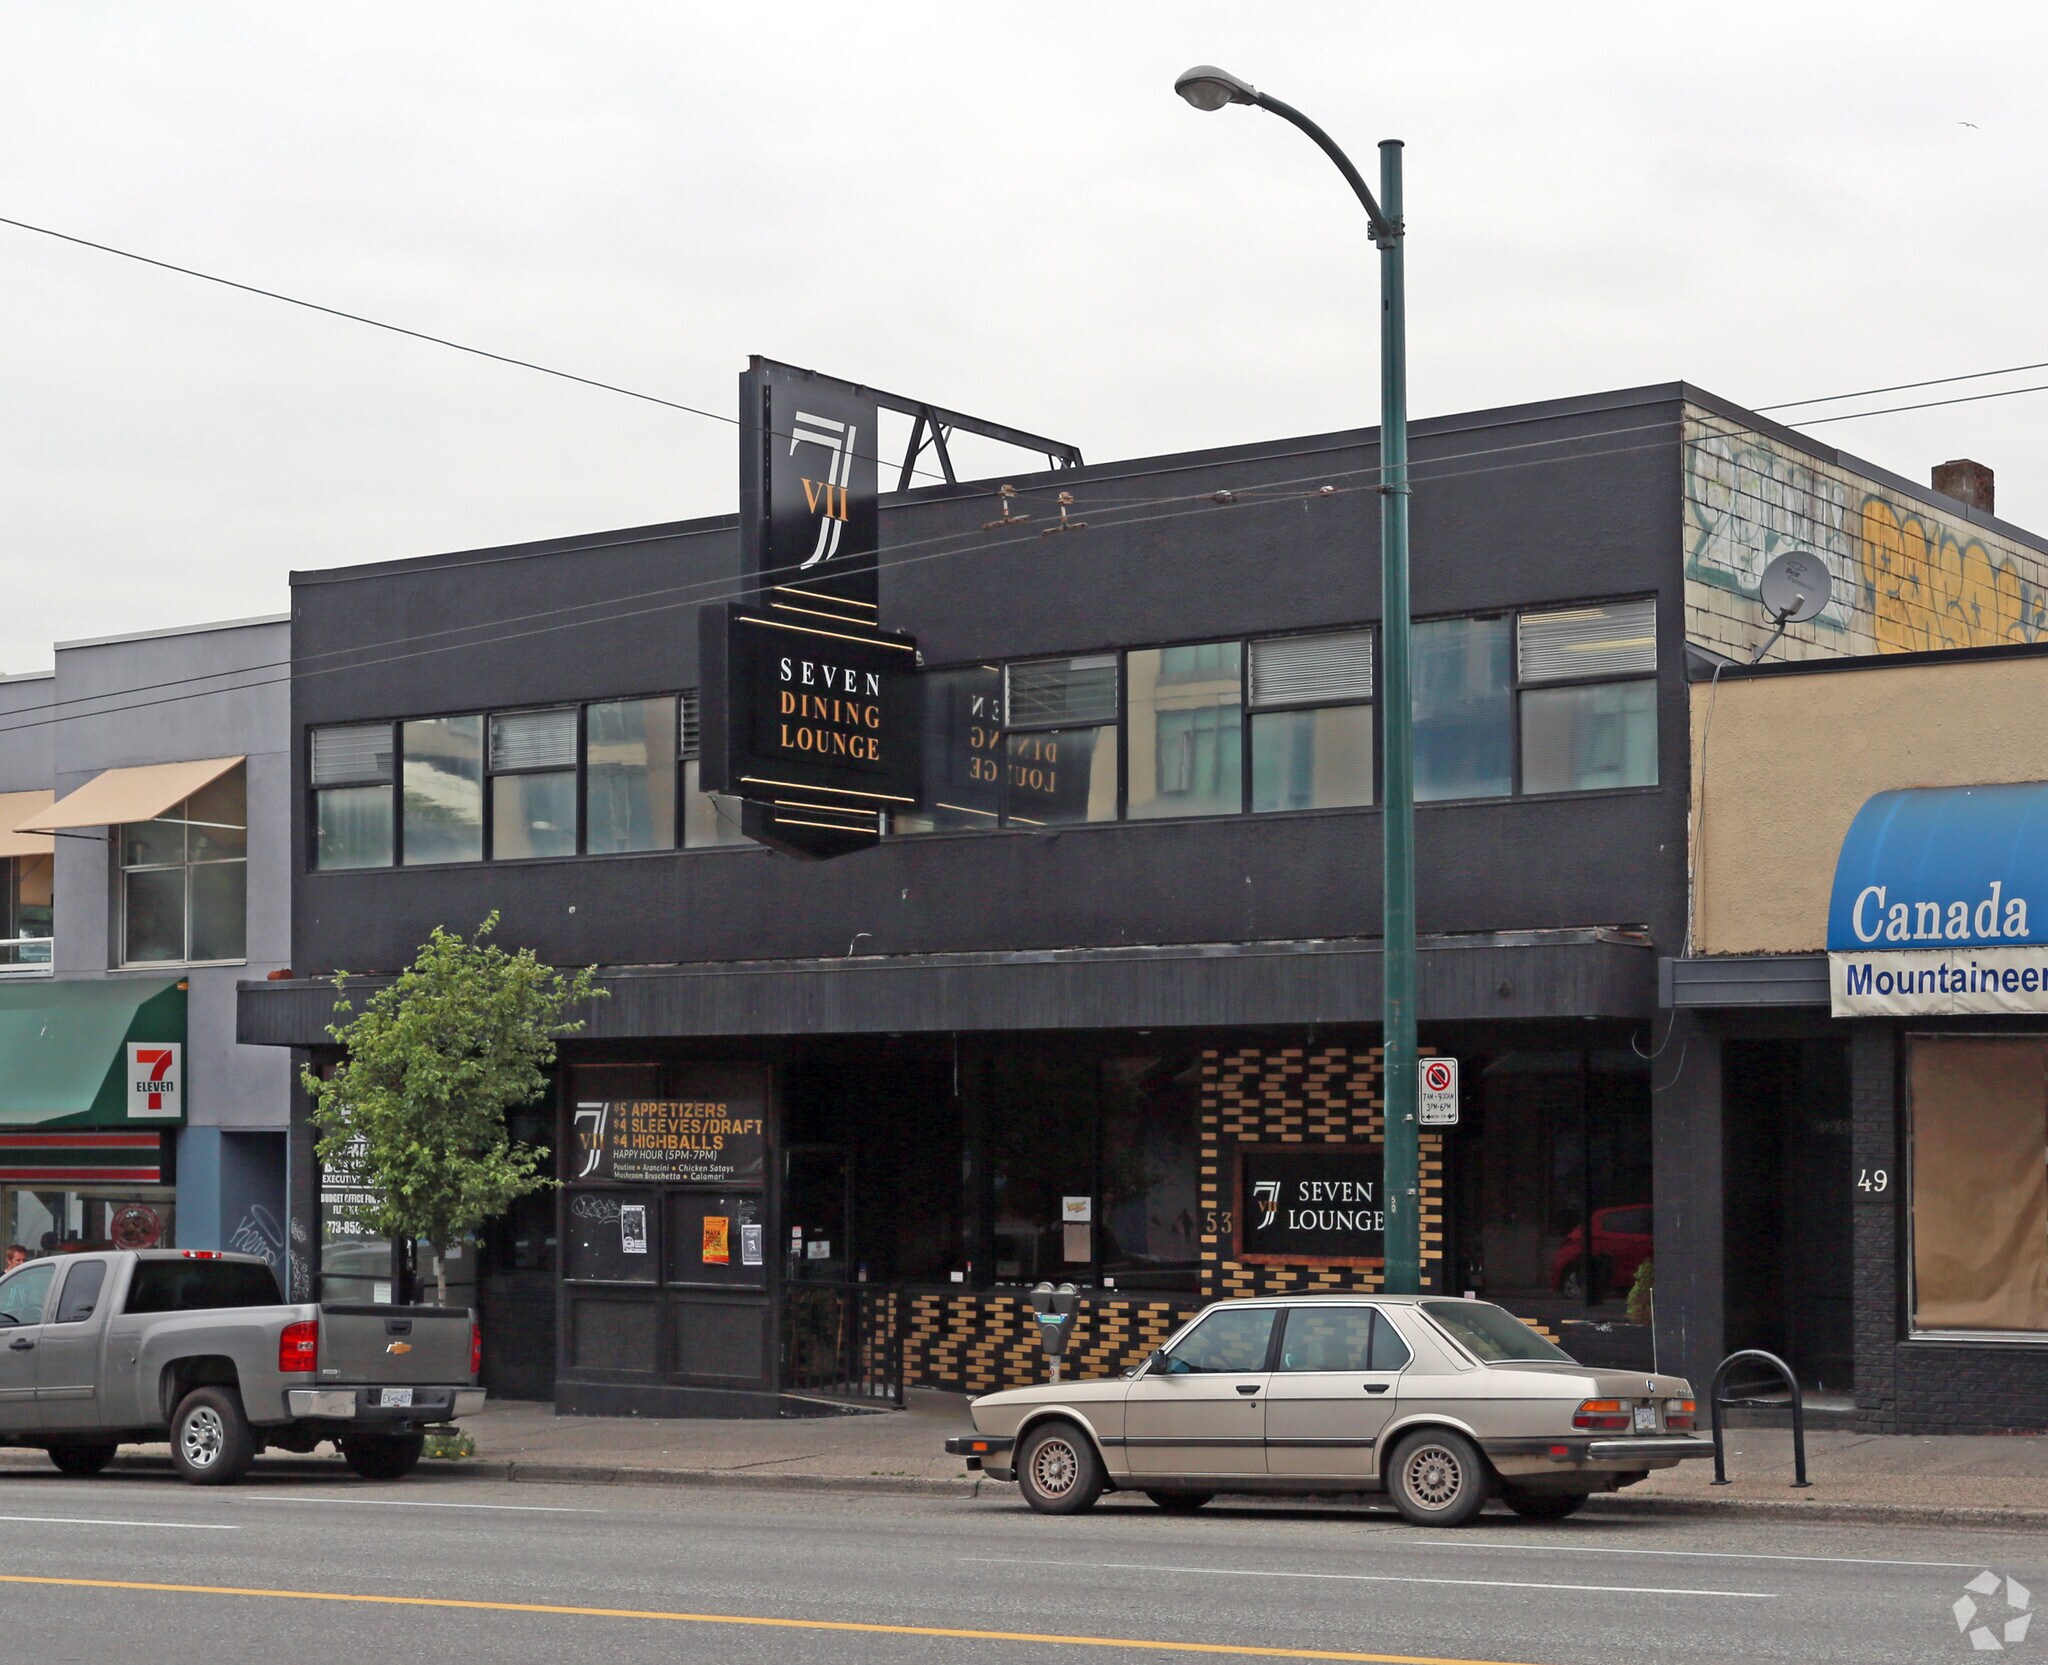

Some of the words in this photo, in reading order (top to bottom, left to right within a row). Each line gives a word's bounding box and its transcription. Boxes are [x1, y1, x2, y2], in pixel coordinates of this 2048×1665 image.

[801, 478, 849, 522] VII
[780, 657, 881, 698] SEVEN
[780, 690, 881, 730] DINING
[780, 723, 881, 762] LOUNGE
[1852, 881, 2029, 943] Canada
[136, 1049, 173, 1110] 7
[613, 1102, 627, 1117] $5
[631, 1102, 728, 1118] APPETIZERS
[613, 1118, 627, 1132] $4
[631, 1118, 763, 1135] SLEEVES/DRAFT
[613, 1133, 628, 1149] $4
[632, 1134, 724, 1150] HIGHBALLS
[613, 1149, 638, 1159] HAPPY
[640, 1150, 663, 1160] HOUR
[665, 1150, 717, 1161] (5PM-7PM)
[613, 1163, 635, 1171] Poutine
[642, 1163, 670, 1172] Arancini
[678, 1164, 708, 1172] Chicken
[709, 1164, 734, 1174] Satays
[614, 1171, 643, 1180] Mushroom
[644, 1172, 681, 1180] Bruschetta
[1299, 1181, 1373, 1202] SEVEN
[1857, 1169, 1888, 1192] 49
[320, 1193, 343, 1203] BUDGET
[344, 1193, 365, 1203] OFFICE
[1206, 1211, 1233, 1234] 53
[1288, 1209, 1385, 1231] LOUNGE
